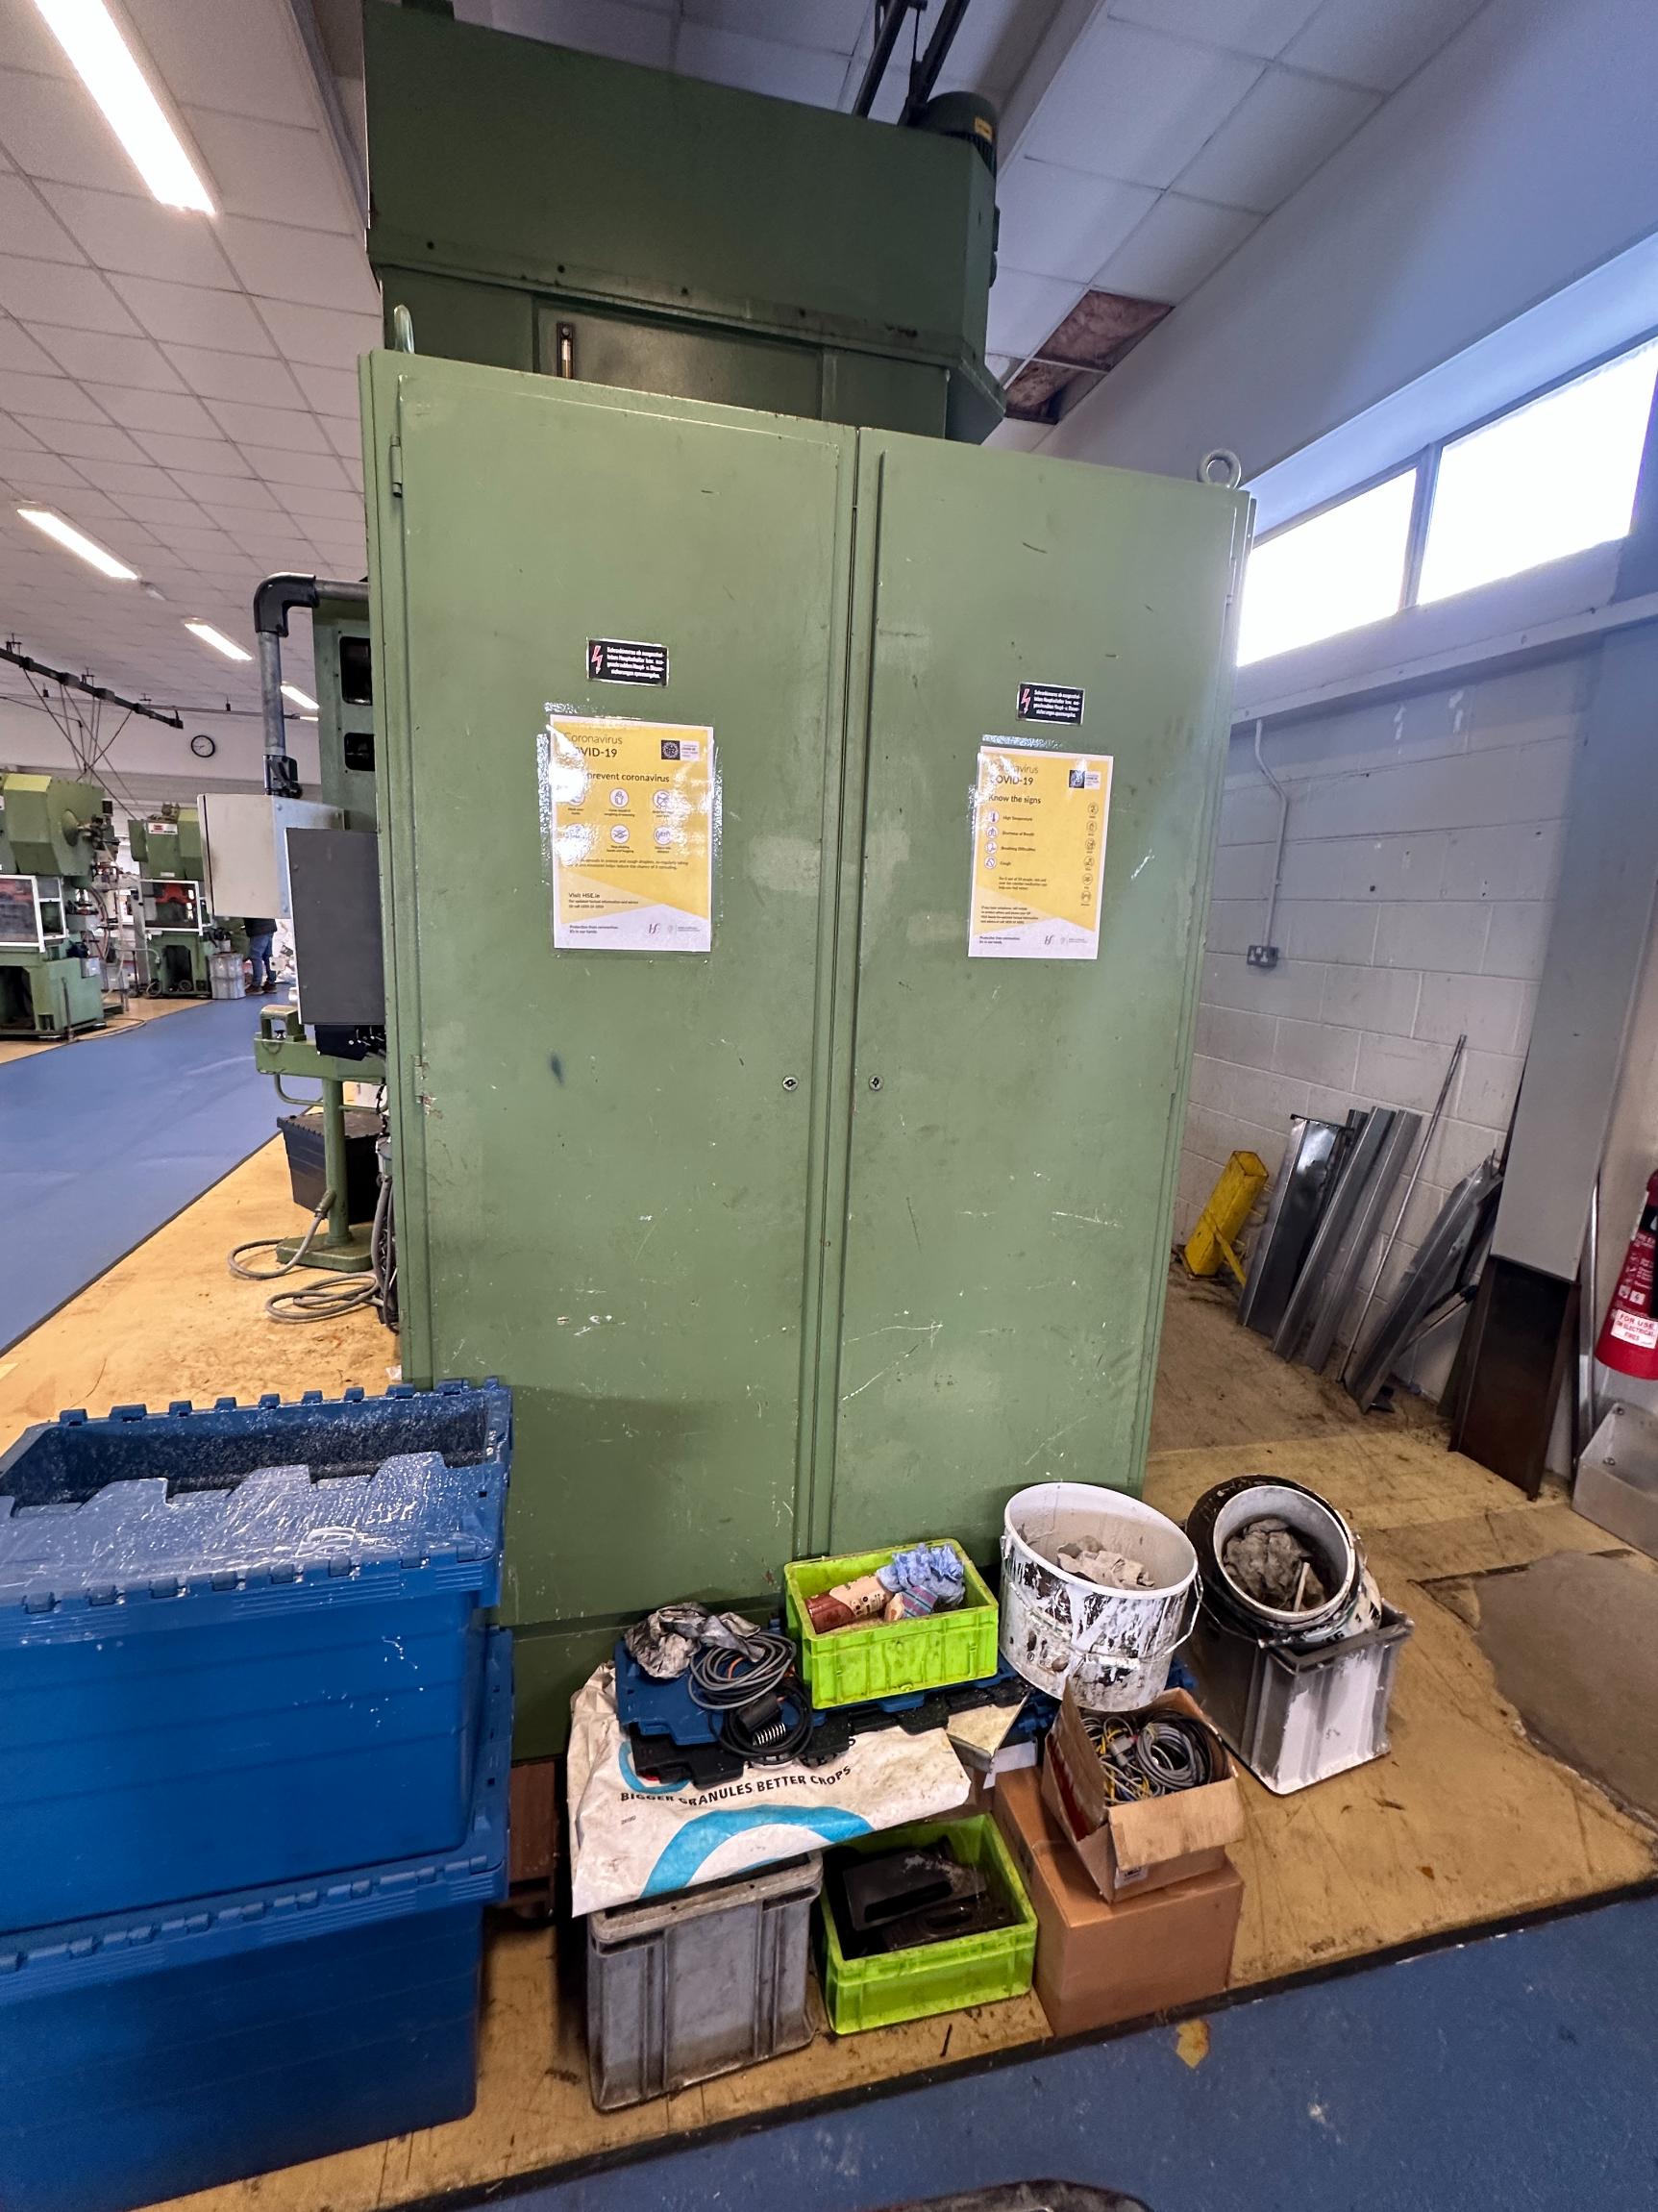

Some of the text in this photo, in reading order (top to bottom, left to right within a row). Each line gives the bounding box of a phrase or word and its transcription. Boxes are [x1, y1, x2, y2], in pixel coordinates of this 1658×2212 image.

[575, 747, 618, 758] VID-19
[586, 772, 670, 783] prevent coronavirus
[1024, 796, 1041, 806] signs
[1620, 1313, 1653, 1330] FOR USE
[621, 1766, 852, 1806] BIGGER GRANULES BETTER CROPS
